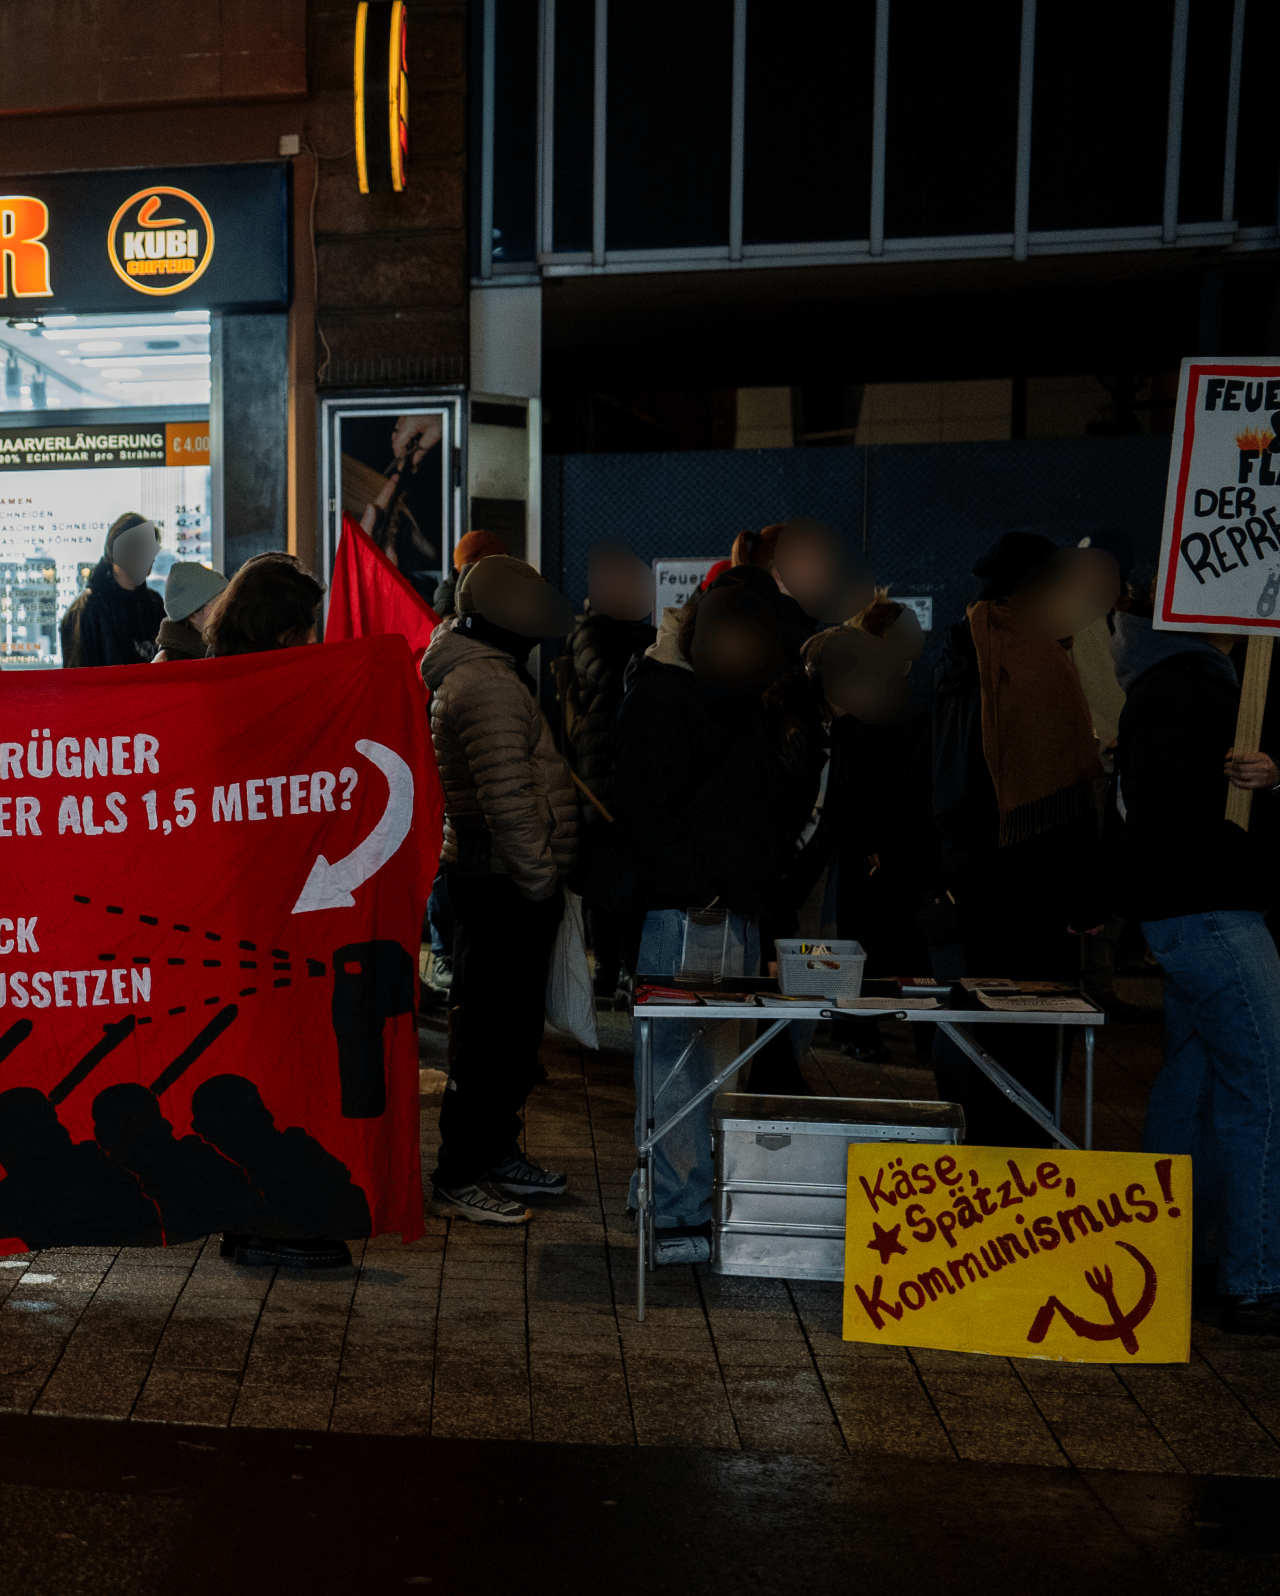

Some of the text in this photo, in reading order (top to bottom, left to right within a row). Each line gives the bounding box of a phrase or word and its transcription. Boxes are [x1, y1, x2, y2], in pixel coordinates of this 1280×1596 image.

[124, 229, 198, 260] KUBI
[127, 258, 195, 276] COIFFEUR
[26, 451, 89, 464] ECHTHAAR
[94, 451, 114, 462] pro
[119, 449, 164, 460] Strähne
[173, 437, 182, 453] €
[1238, 448, 1280, 486] FL
[1194, 486, 1257, 520] DER
[0, 728, 160, 781] RÜGNER
[58, 792, 128, 836] ALS
[141, 788, 197, 836] 1,5
[212, 766, 359, 824] METER?
[858, 1154, 979, 1213] Käse,
[905, 1159, 1076, 1248] Spätzle,
[854, 1158, 1182, 1330] Kommunismus!
